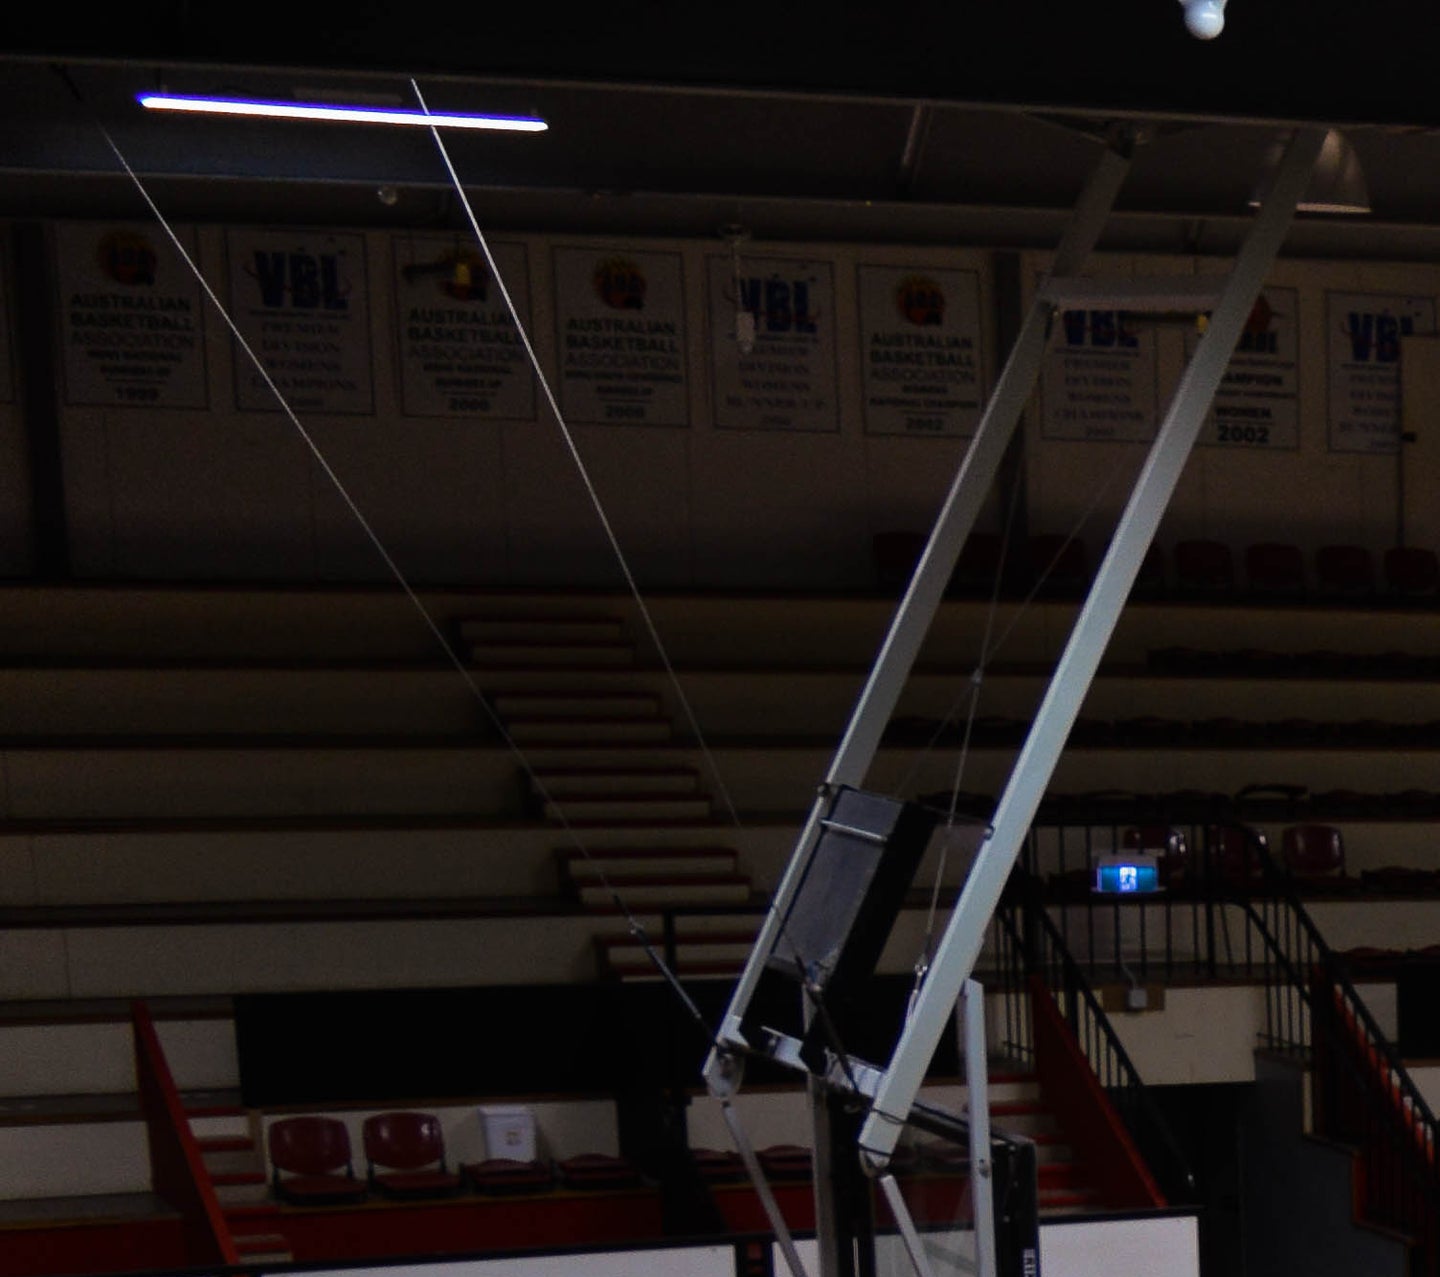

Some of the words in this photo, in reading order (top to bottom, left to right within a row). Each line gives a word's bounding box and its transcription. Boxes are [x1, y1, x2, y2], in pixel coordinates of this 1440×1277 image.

[566, 317, 676, 335] AUSTRALIAN
[564, 334, 677, 352] BASKETBALL
[871, 332, 973, 350] AUSTRALIAN
[869, 350, 974, 368] BASKETBALL
[1217, 425, 1270, 445] 2002
